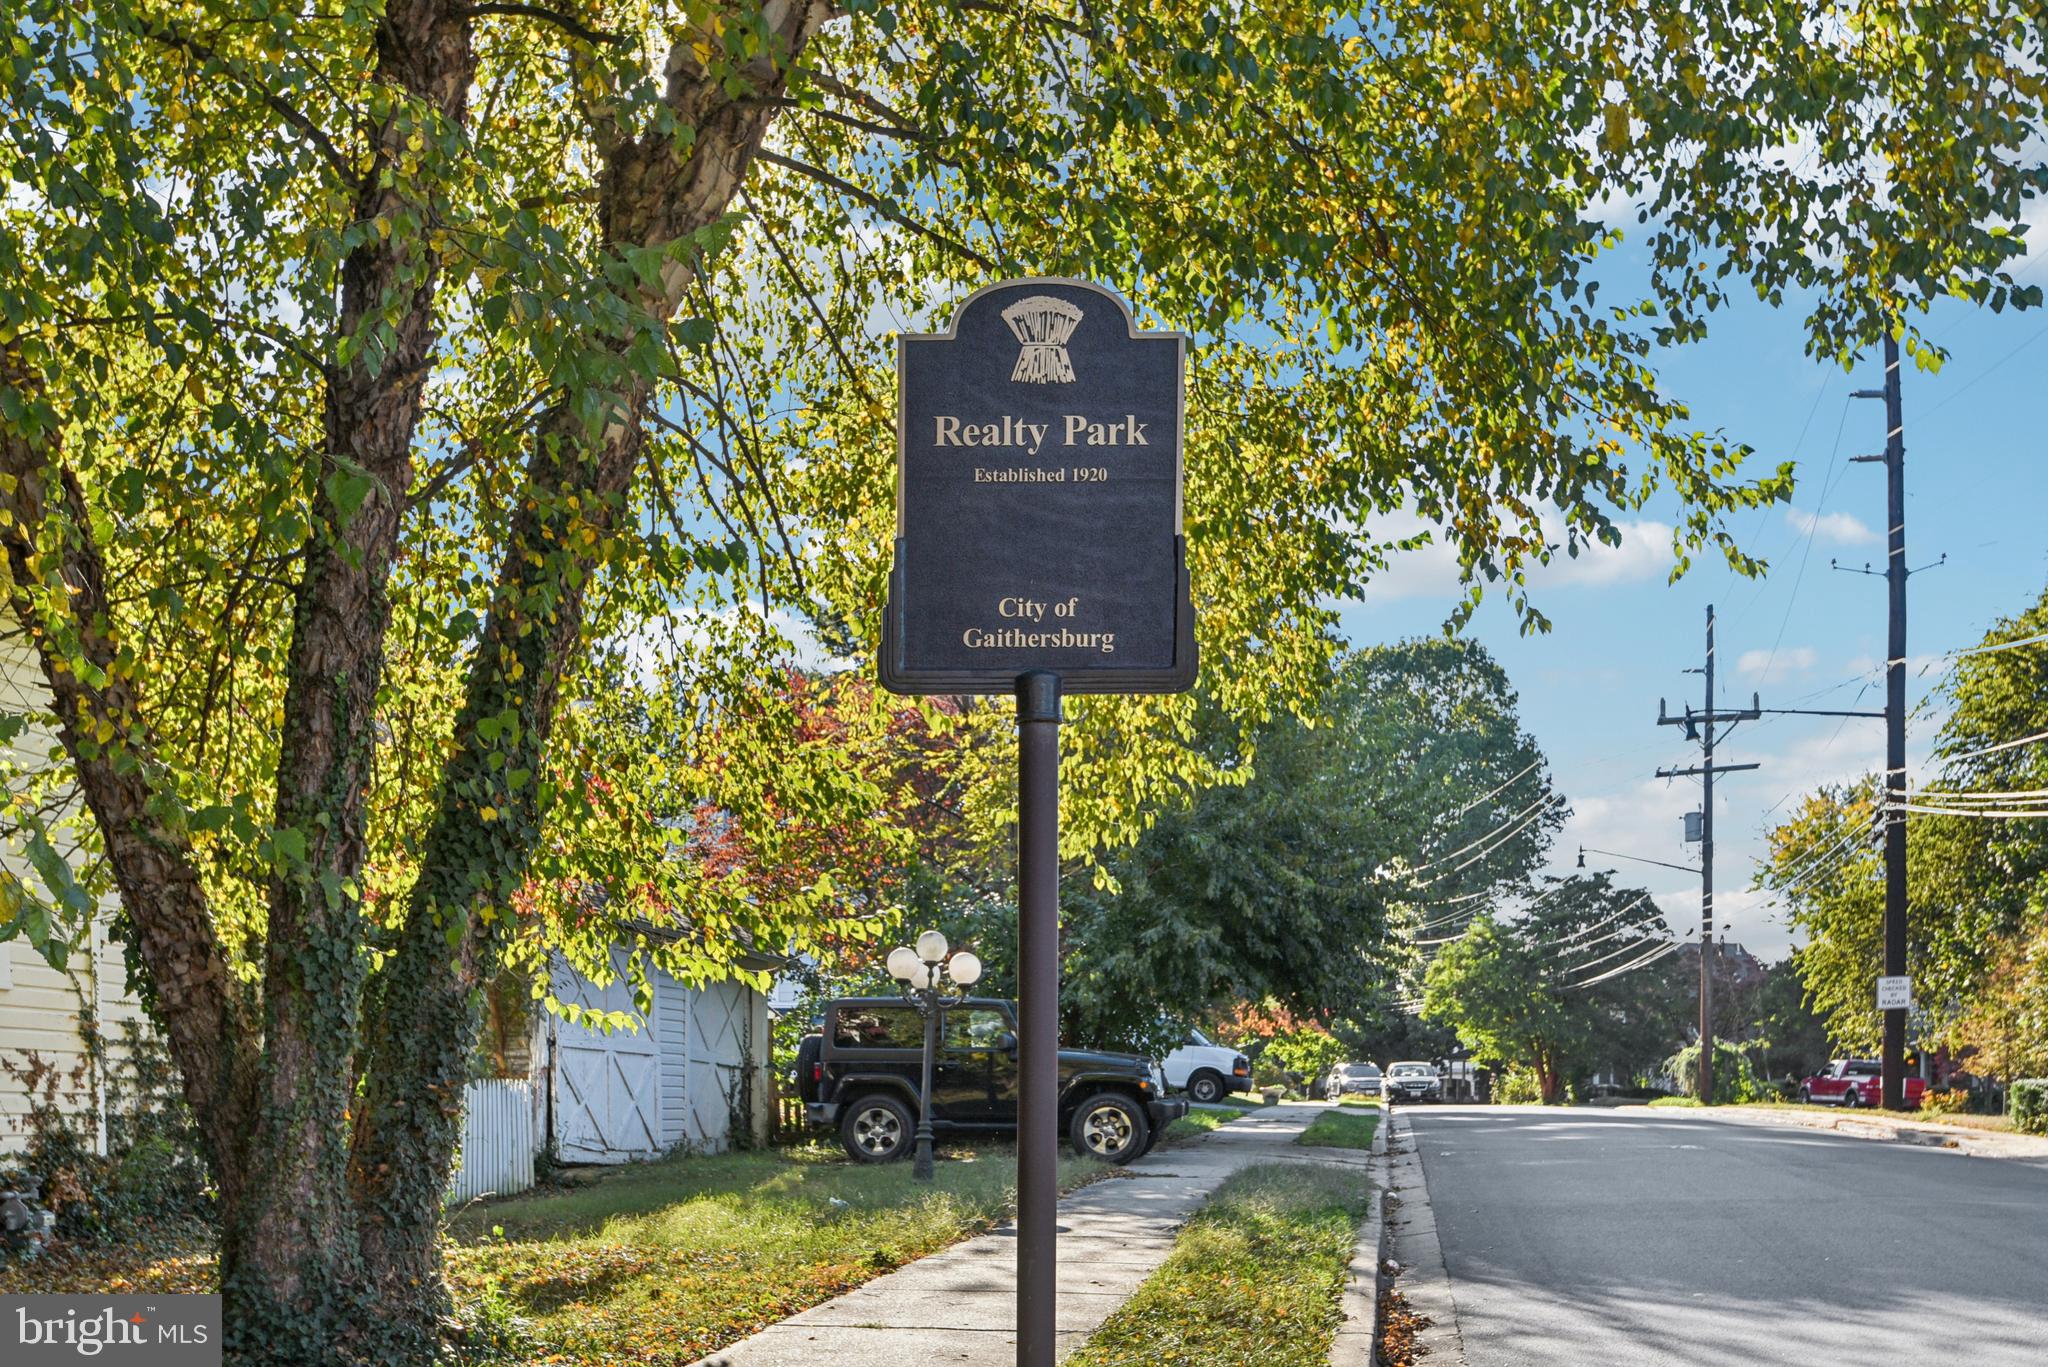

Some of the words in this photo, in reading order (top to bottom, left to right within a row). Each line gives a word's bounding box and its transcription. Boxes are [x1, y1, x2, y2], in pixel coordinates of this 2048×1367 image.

[933, 414, 1049, 455] Realty
[1062, 414, 1149, 447] Park
[973, 467, 1066, 484] Established
[1071, 467, 1109, 484] 1920
[998, 597, 1048, 623] City
[1054, 597, 1079, 617] of
[962, 628, 1115, 653] Gaithersburg
